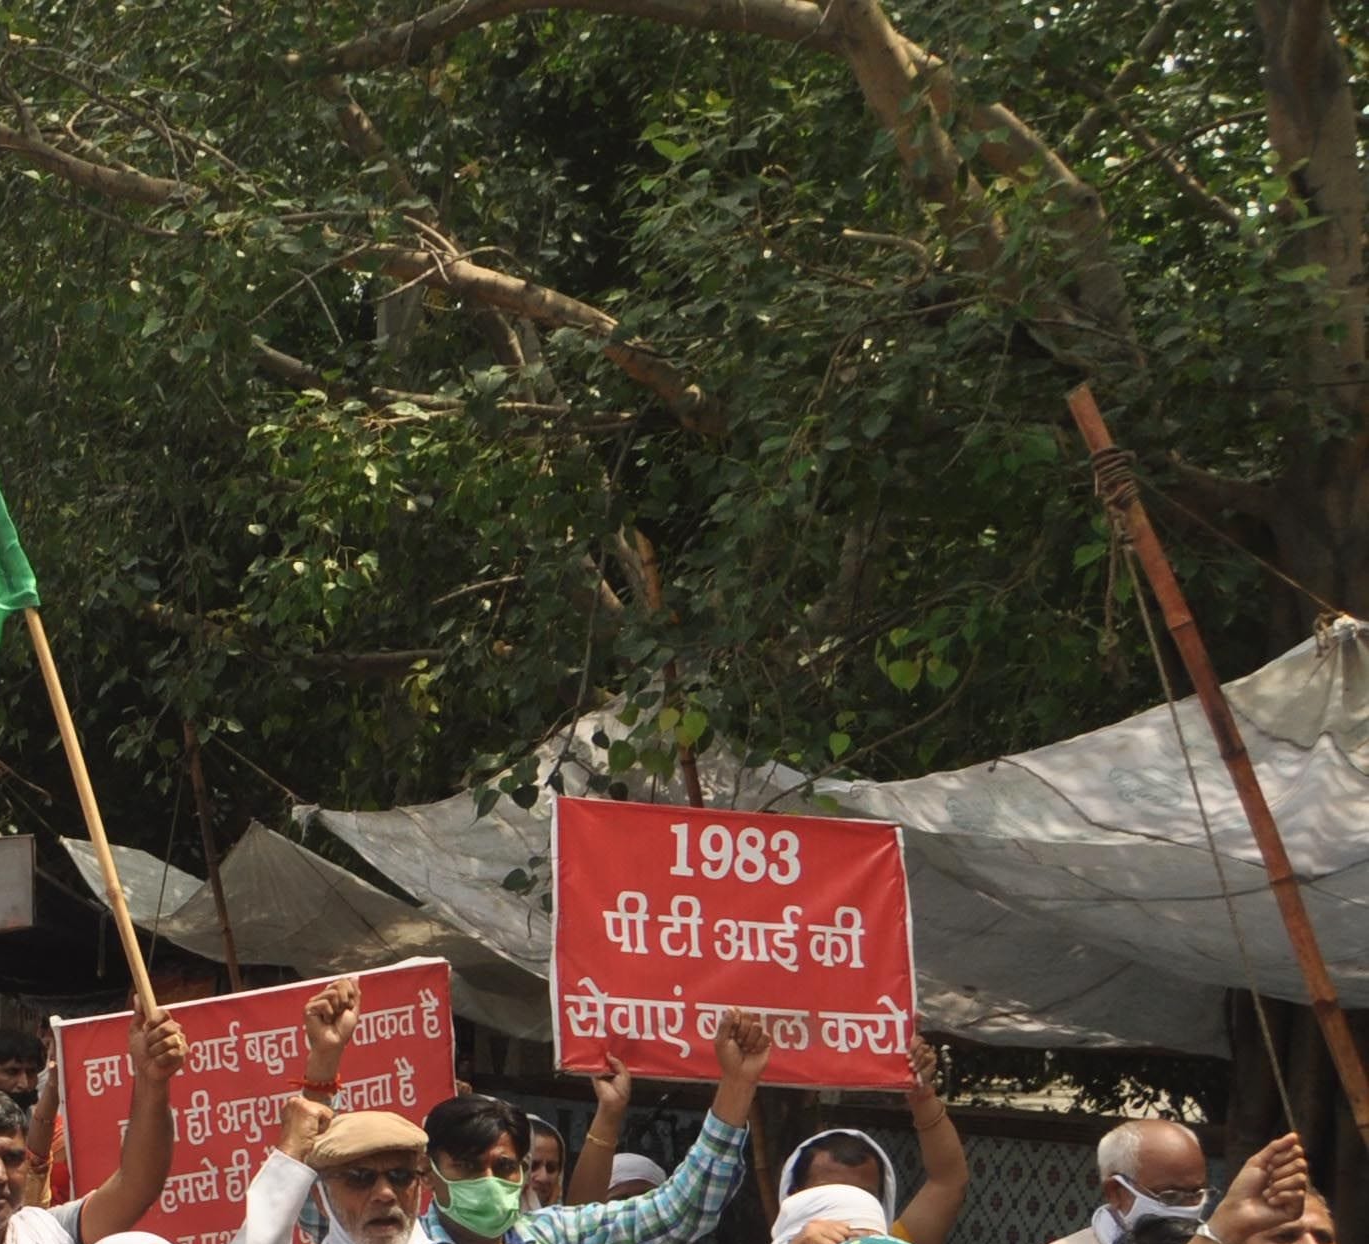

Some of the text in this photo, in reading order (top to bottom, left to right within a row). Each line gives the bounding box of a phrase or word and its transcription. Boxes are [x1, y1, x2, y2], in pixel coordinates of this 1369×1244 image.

[669, 822, 802, 886] 1983
[602, 890, 866, 973] पी टी आई की
[84, 1055, 122, 1097] हम
[190, 1021, 240, 1073] आई
[243, 1026, 298, 1076] बहुत
[351, 1004, 416, 1047] ताकत
[418, 988, 442, 1040] है
[564, 976, 692, 1059] सेवाएं
[817, 995, 909, 1056] करो
[184, 1089, 212, 1146] ही
[393, 1056, 417, 1108] है
[160, 1148, 251, 1214] हमसे ही
